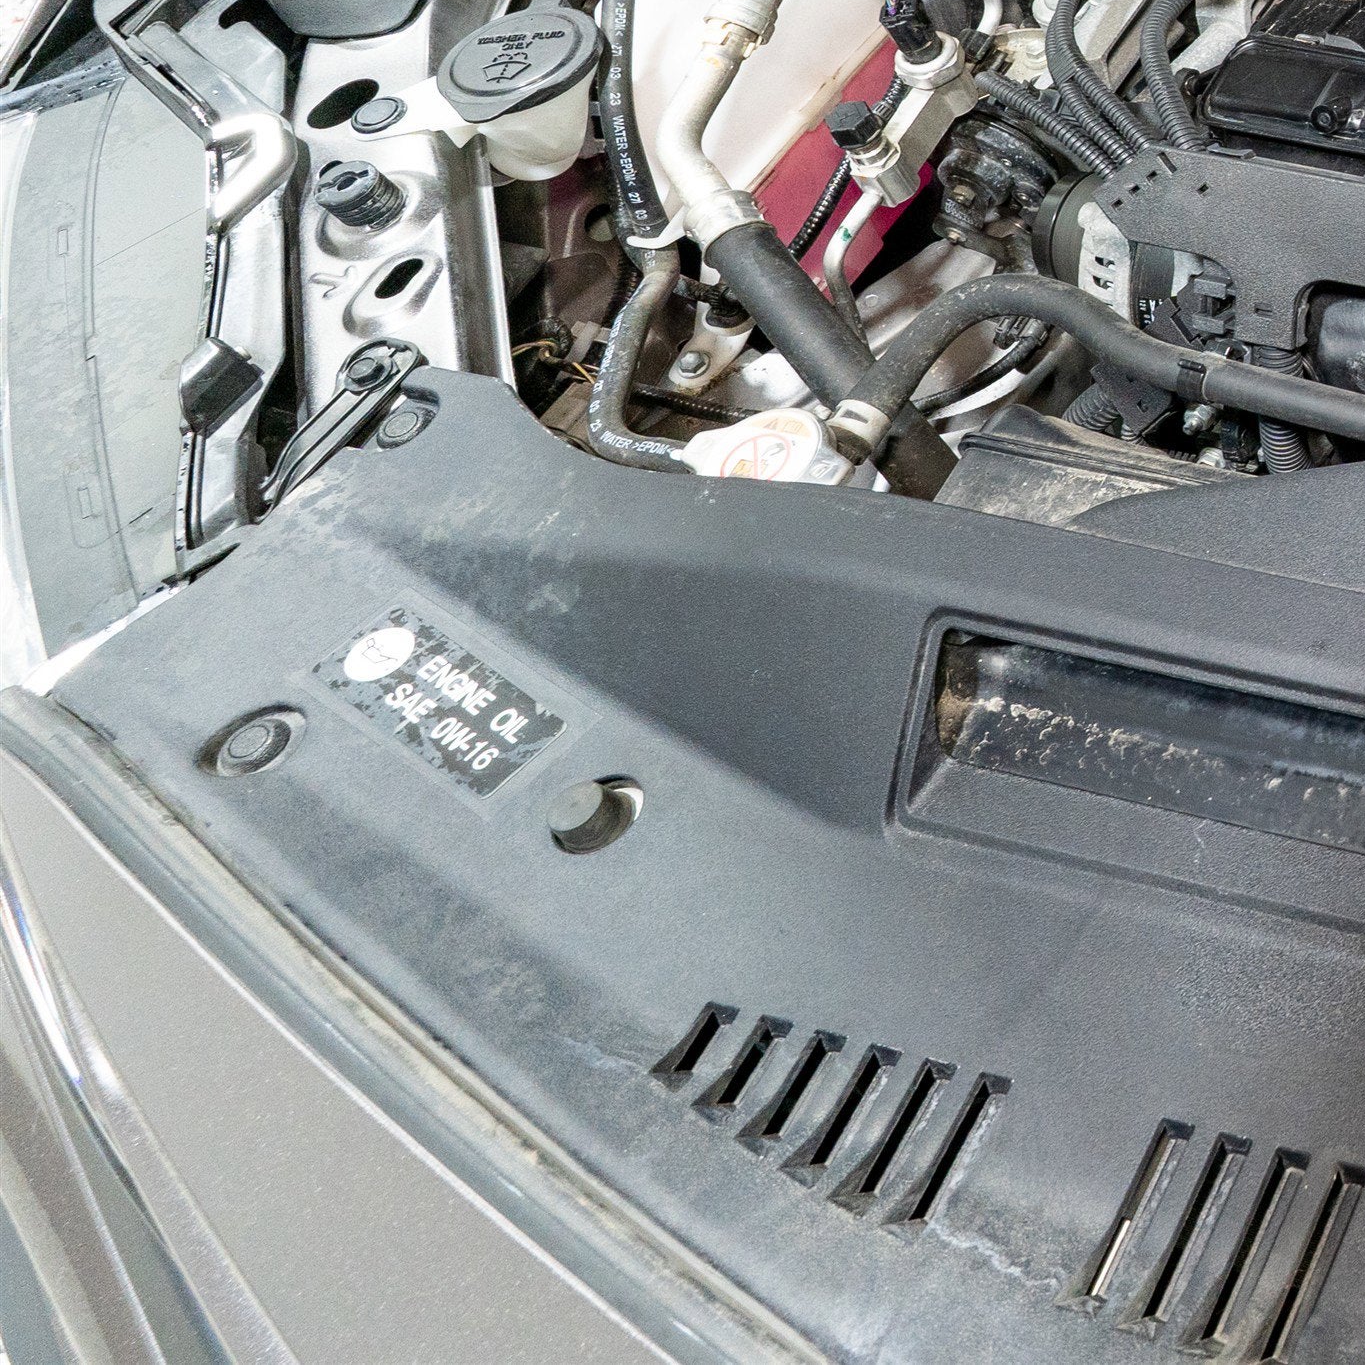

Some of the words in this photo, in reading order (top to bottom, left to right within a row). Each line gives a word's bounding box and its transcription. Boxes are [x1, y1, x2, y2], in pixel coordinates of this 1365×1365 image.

[477, 34, 526, 45] WASHER
[532, 30, 565, 40] FLUID
[502, 41, 533, 51] ONLY
[610, 92, 622, 106] 23
[612, 115, 628, 151] WATER
[600, 430, 634, 449] WATER
[417, 656, 496, 716] ENGINE
[489, 708, 530, 744] OIL
[385, 683, 437, 724] SAE
[431, 717, 499, 771] 0W-16
